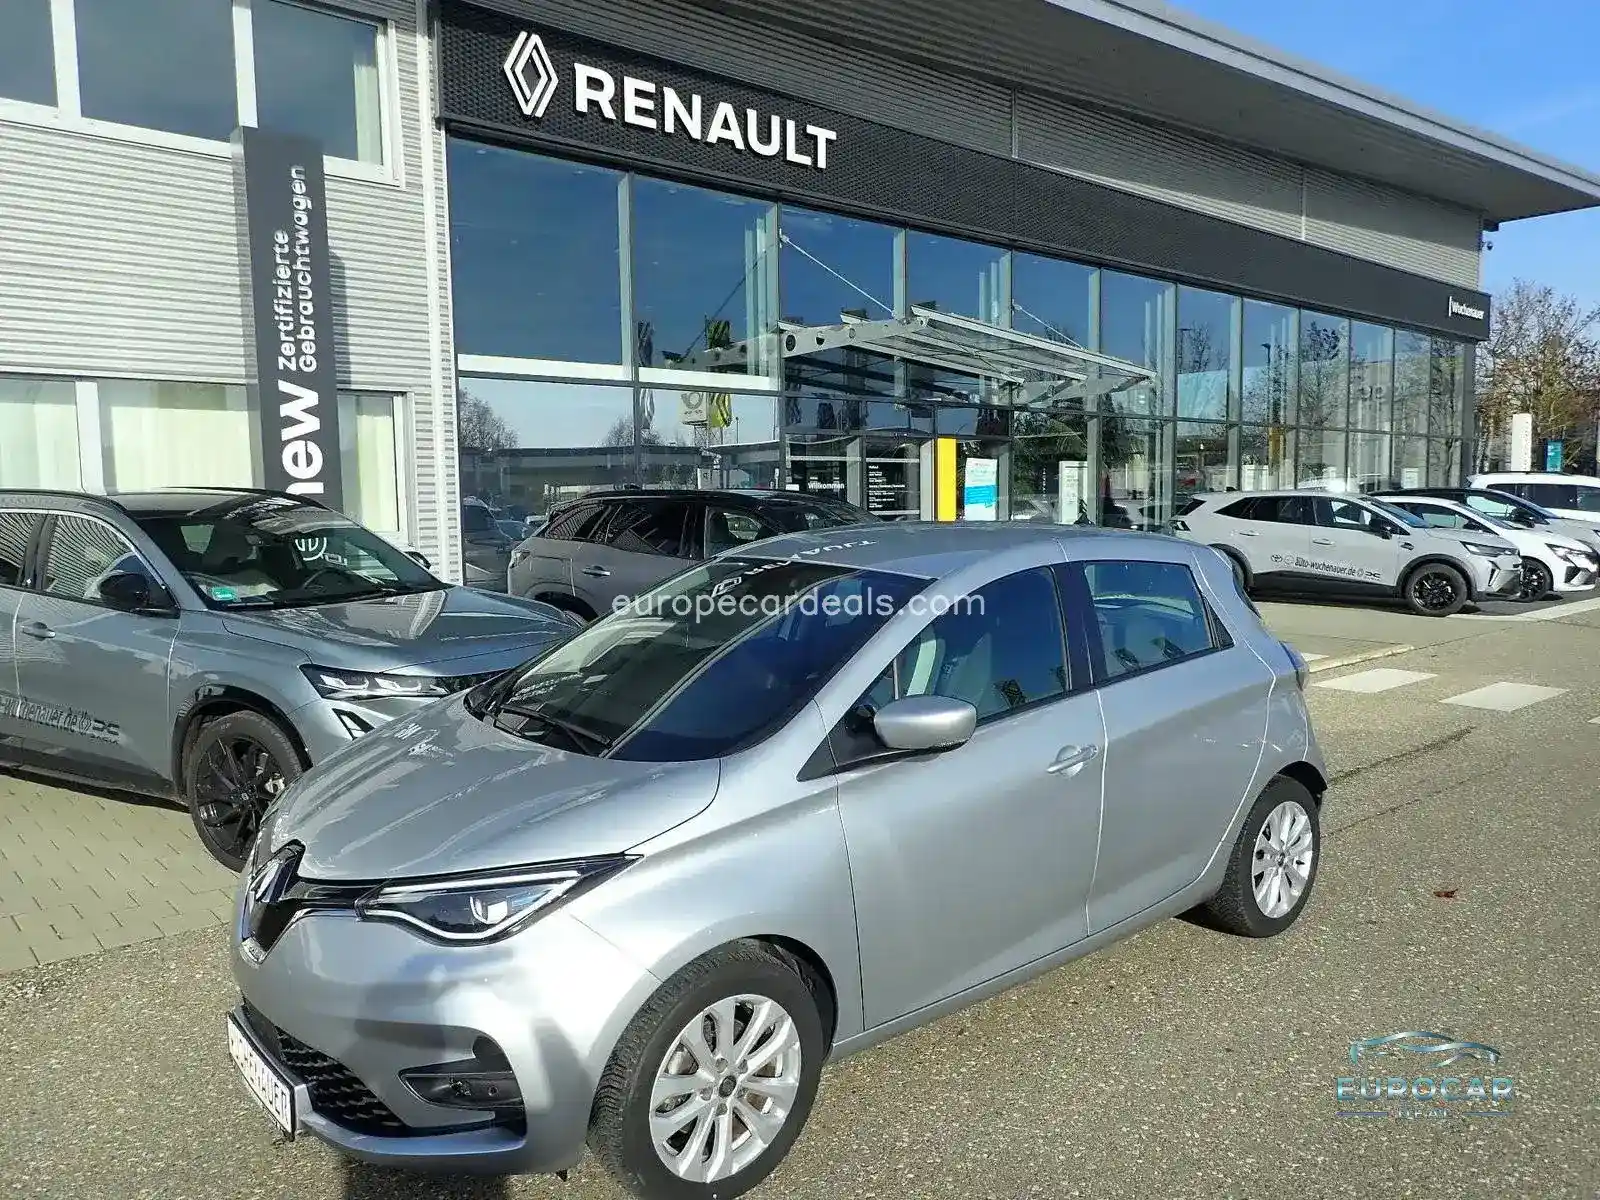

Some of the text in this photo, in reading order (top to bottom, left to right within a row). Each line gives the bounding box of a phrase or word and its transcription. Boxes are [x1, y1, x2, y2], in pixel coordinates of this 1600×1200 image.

[573, 62, 837, 169] RENAULT
[273, 229, 296, 372] Zertifizierte
[291, 165, 318, 373] Gebrauchtwagen
[808, 482, 845, 490] Willkommen
